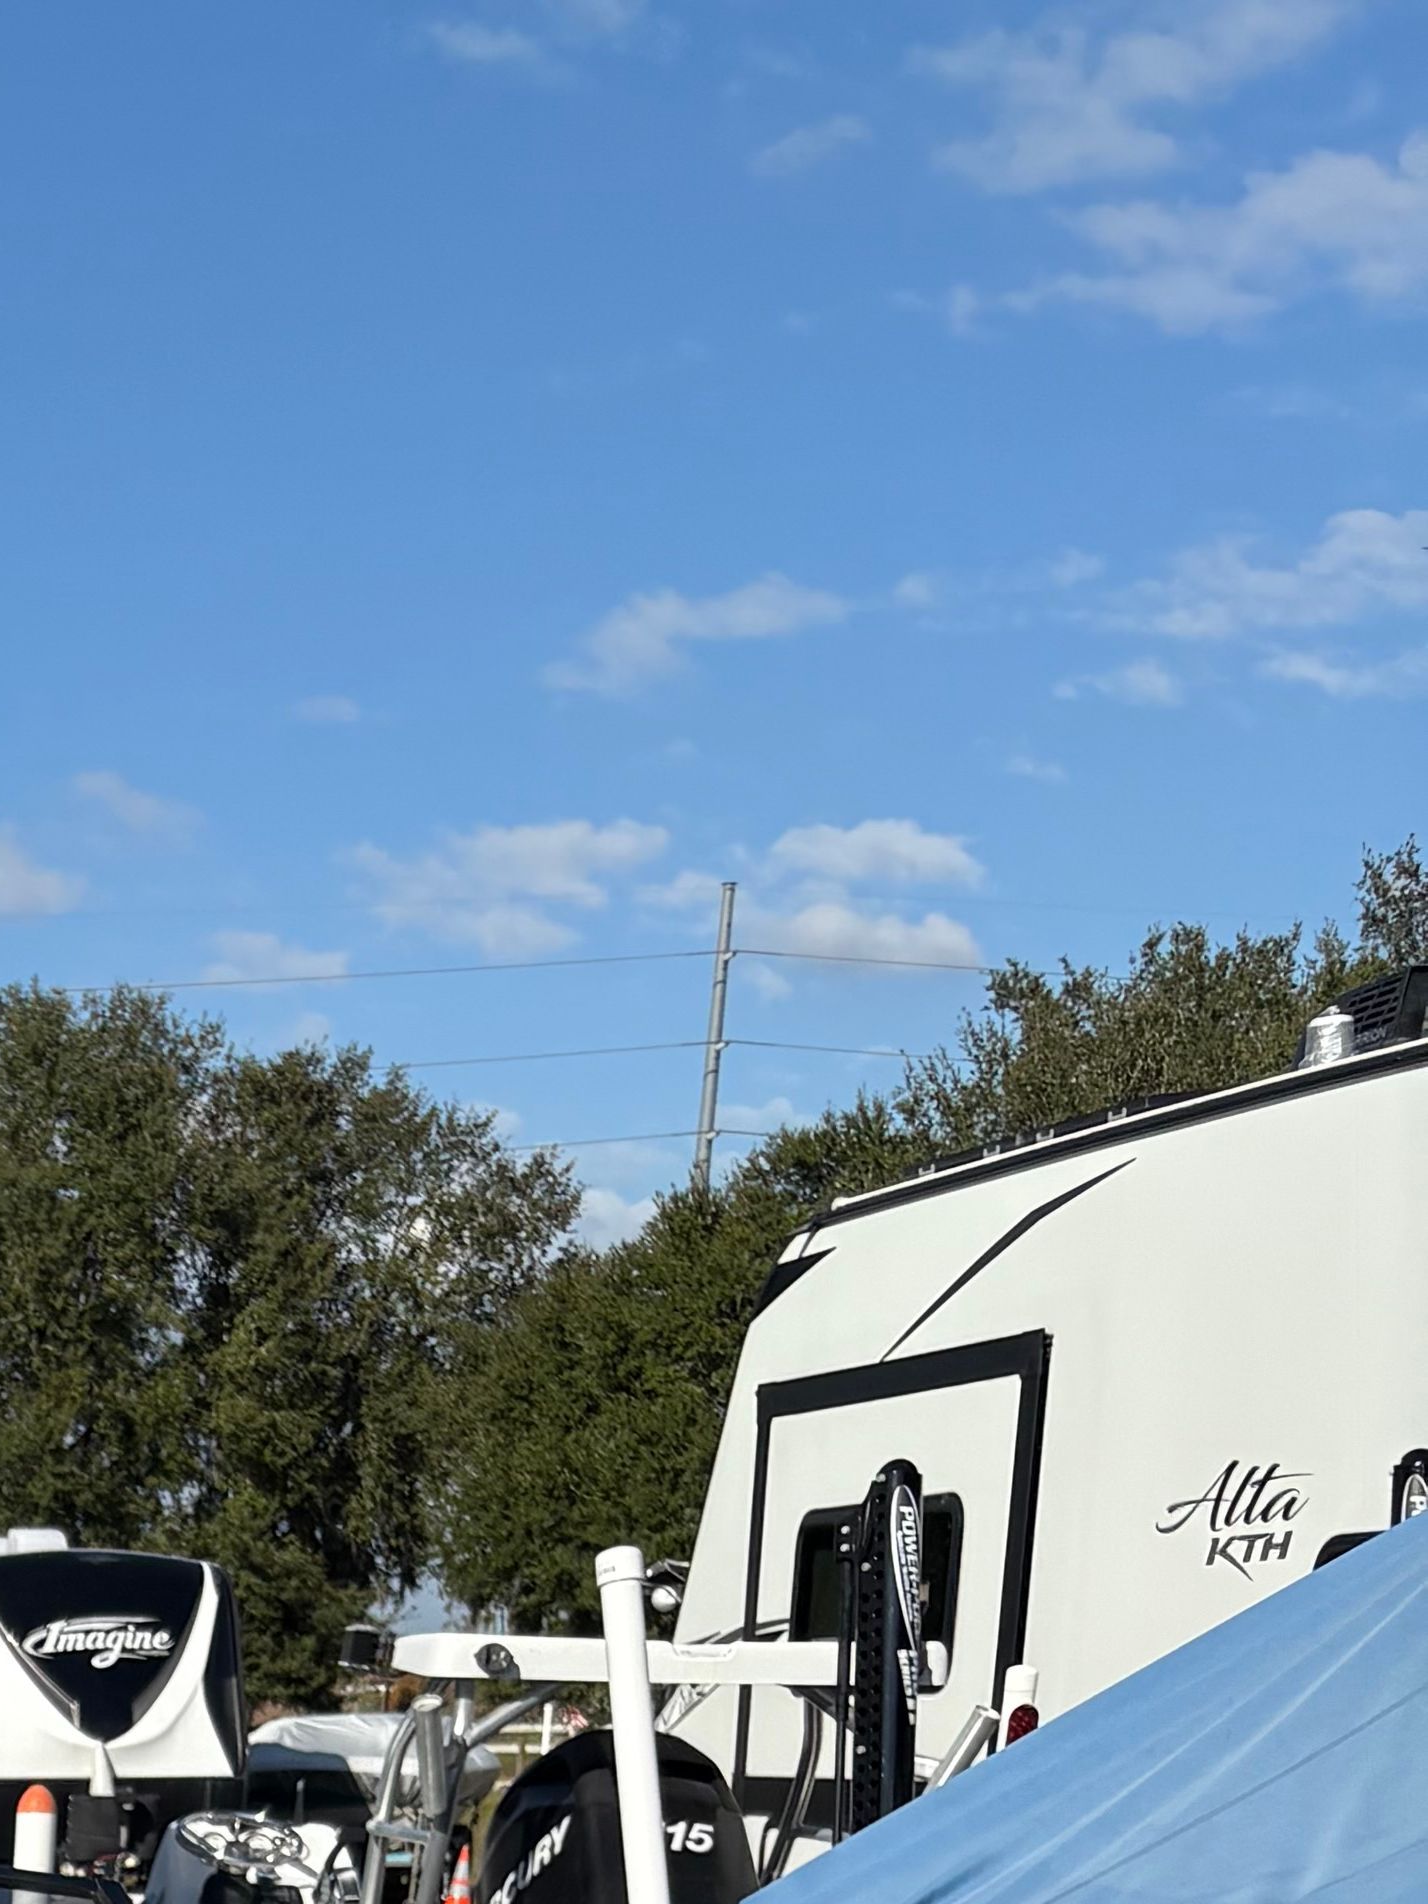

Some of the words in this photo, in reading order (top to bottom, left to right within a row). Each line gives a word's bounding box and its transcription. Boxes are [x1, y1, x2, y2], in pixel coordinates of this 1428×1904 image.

[1156, 1460, 1314, 1533] Alta
[1206, 1530, 1293, 1581] KTH
[23, 1617, 176, 1669] Imagine
[662, 1821, 714, 1853] 15
